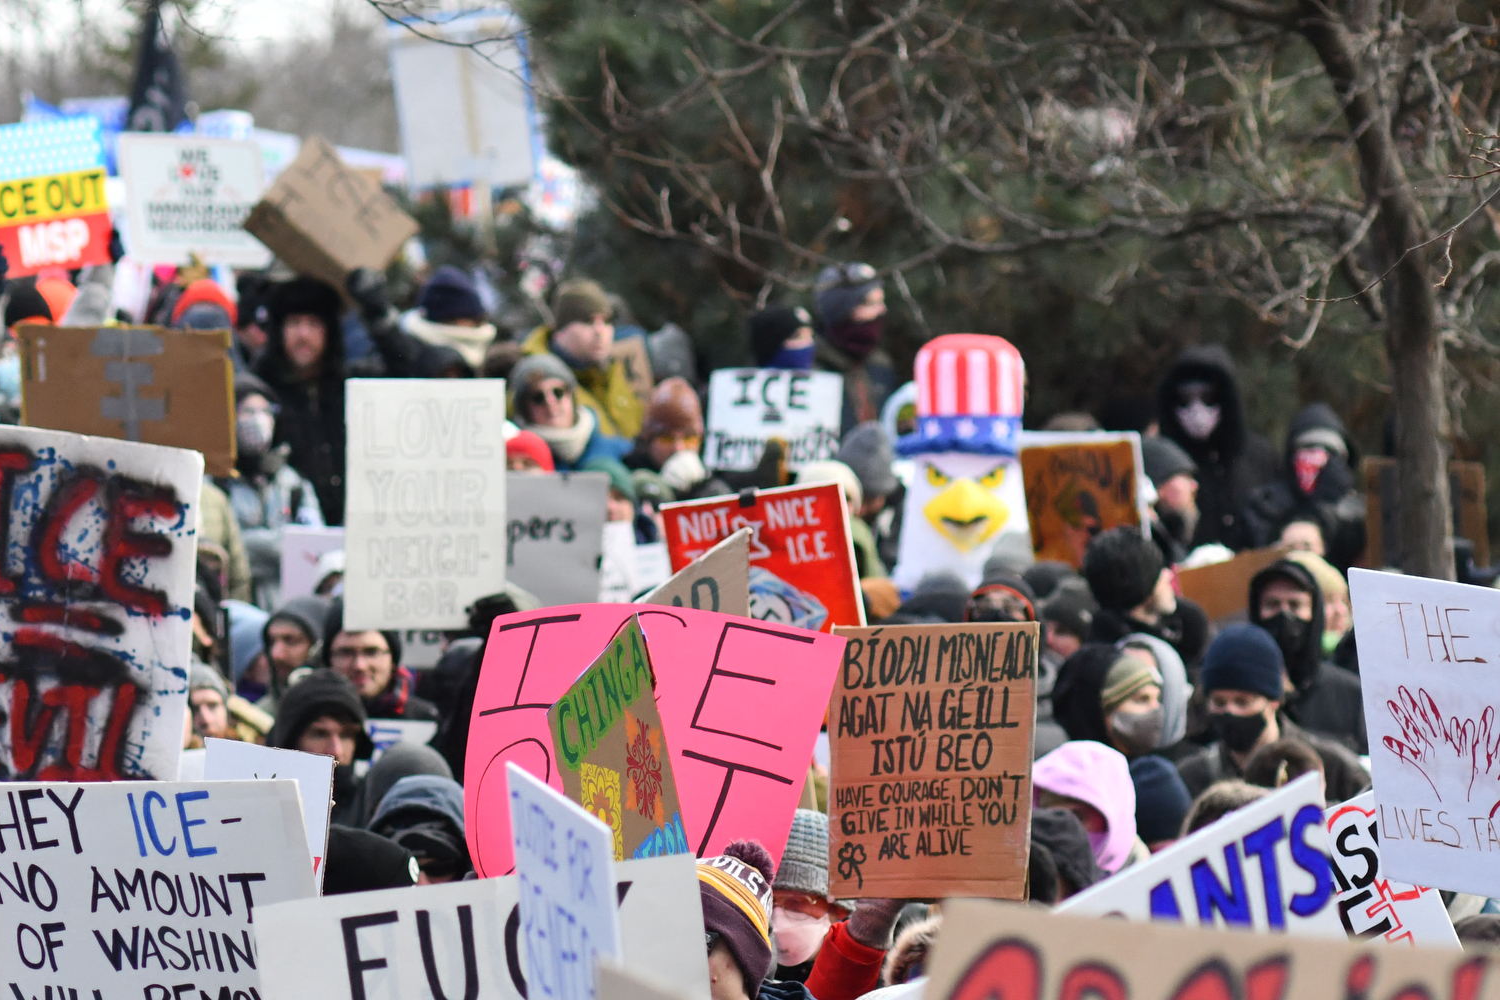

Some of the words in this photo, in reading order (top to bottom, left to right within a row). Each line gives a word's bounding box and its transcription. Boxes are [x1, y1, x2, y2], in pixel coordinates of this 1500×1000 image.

[45, 173, 101, 212] OUT
[17, 217, 91, 269] MSP
[732, 374, 812, 410] ICE
[362, 397, 494, 460] LOVE
[365, 467, 489, 527] YOUR
[677, 507, 730, 545] NOT
[764, 496, 821, 531] NICE
[843, 628, 931, 690] BÍODH
[1386, 603, 1488, 663] THE
[557, 624, 650, 772] CHINGA
[838, 692, 895, 738] AGAT
[901, 690, 933, 732] NA
[938, 682, 1019, 730] GÉILL
[936, 731, 994, 772] BEO
[475, 737, 795, 879] OT
[836, 784, 874, 810] HAVE
[960, 770, 1026, 802] DON'T
[840, 809, 889, 836] GIVE
[894, 806, 915, 831] IN
[919, 801, 975, 829] WHILE
[978, 801, 1017, 826] YOU
[878, 832, 911, 861] ARE
[915, 828, 973, 856] ALIVE
[1380, 804, 1464, 849] LIVES
[1100, 804, 1336, 932] NTS
[90, 865, 266, 924] AMOUNT
[16, 922, 66, 973] OF
[92, 926, 258, 973] WASHIN
